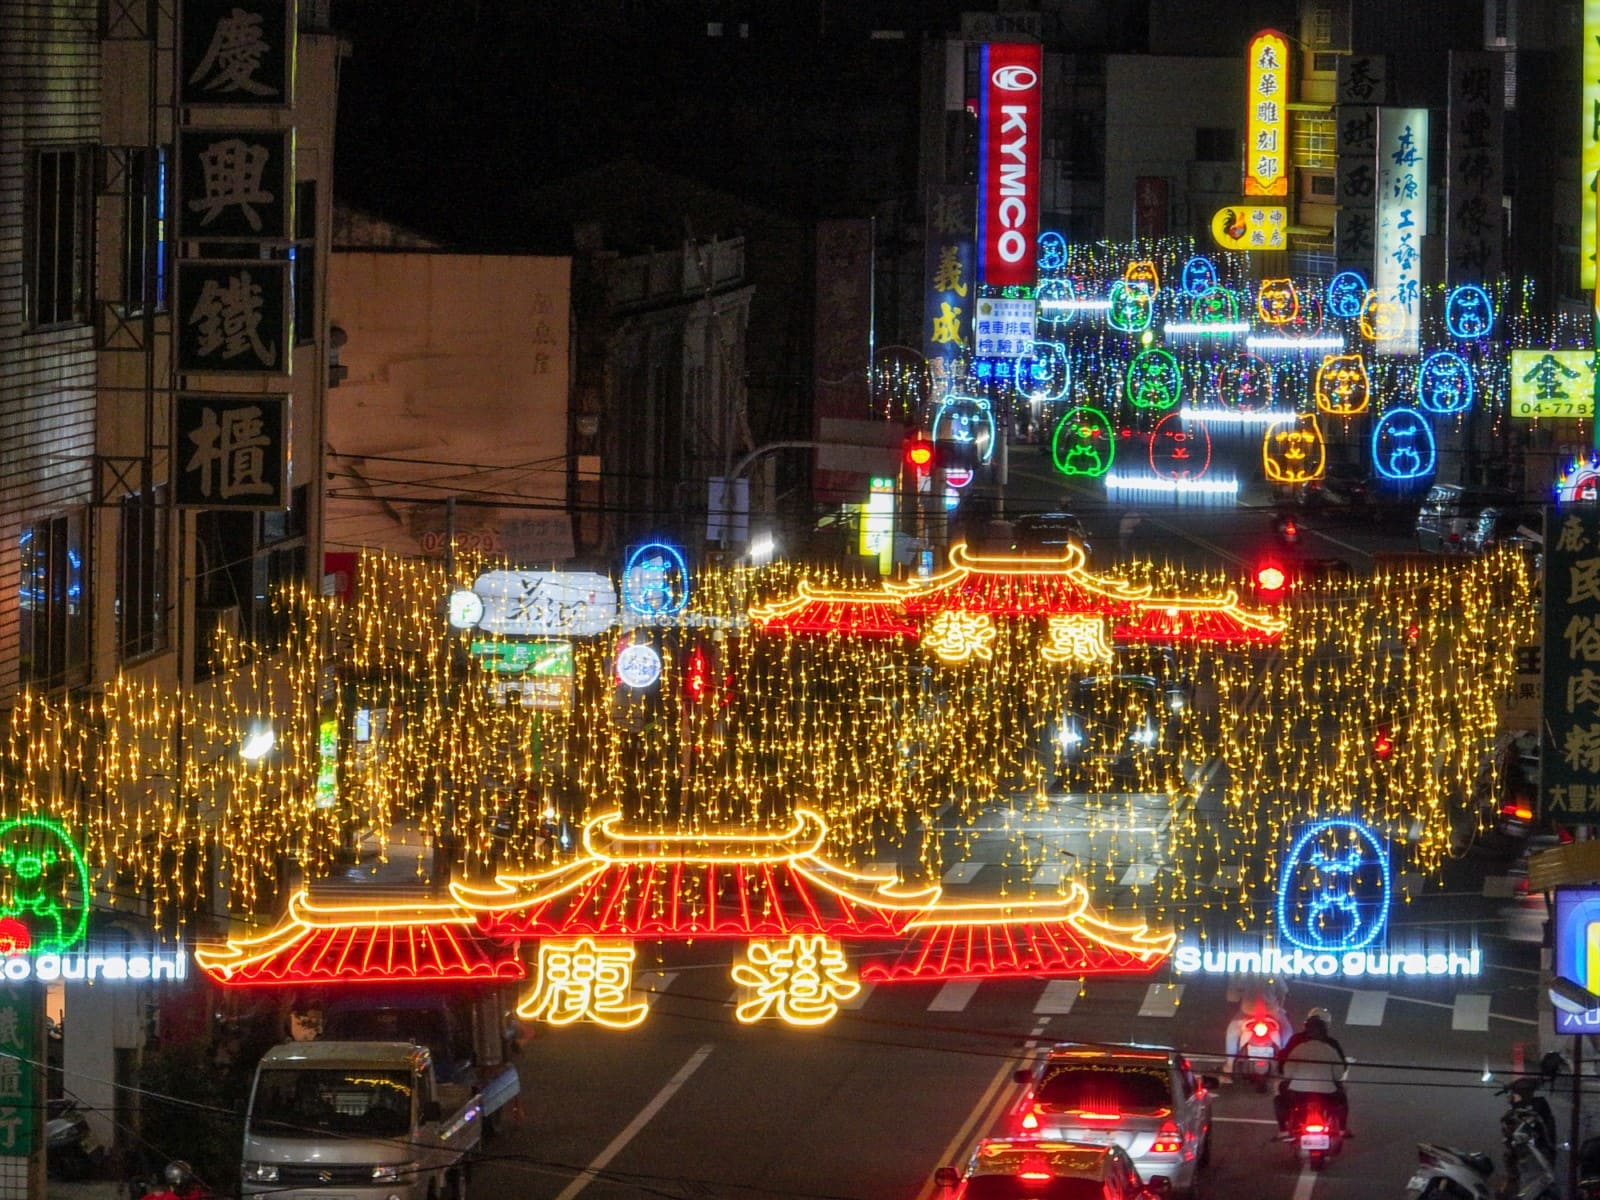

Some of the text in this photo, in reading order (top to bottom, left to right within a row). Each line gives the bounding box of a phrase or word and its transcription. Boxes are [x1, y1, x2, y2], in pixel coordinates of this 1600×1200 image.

[1257, 46, 1280, 178] 森華雕刻部
[997, 105, 1027, 263] KYMCO
[189, 7, 279, 500] 慶興鐵櫃
[979, 321, 1031, 335] 機車排氣
[36, 952, 187, 981] gurashi
[516, 937, 861, 1028] 鹿港
[1174, 946, 1481, 976] Sumikko gurashi
